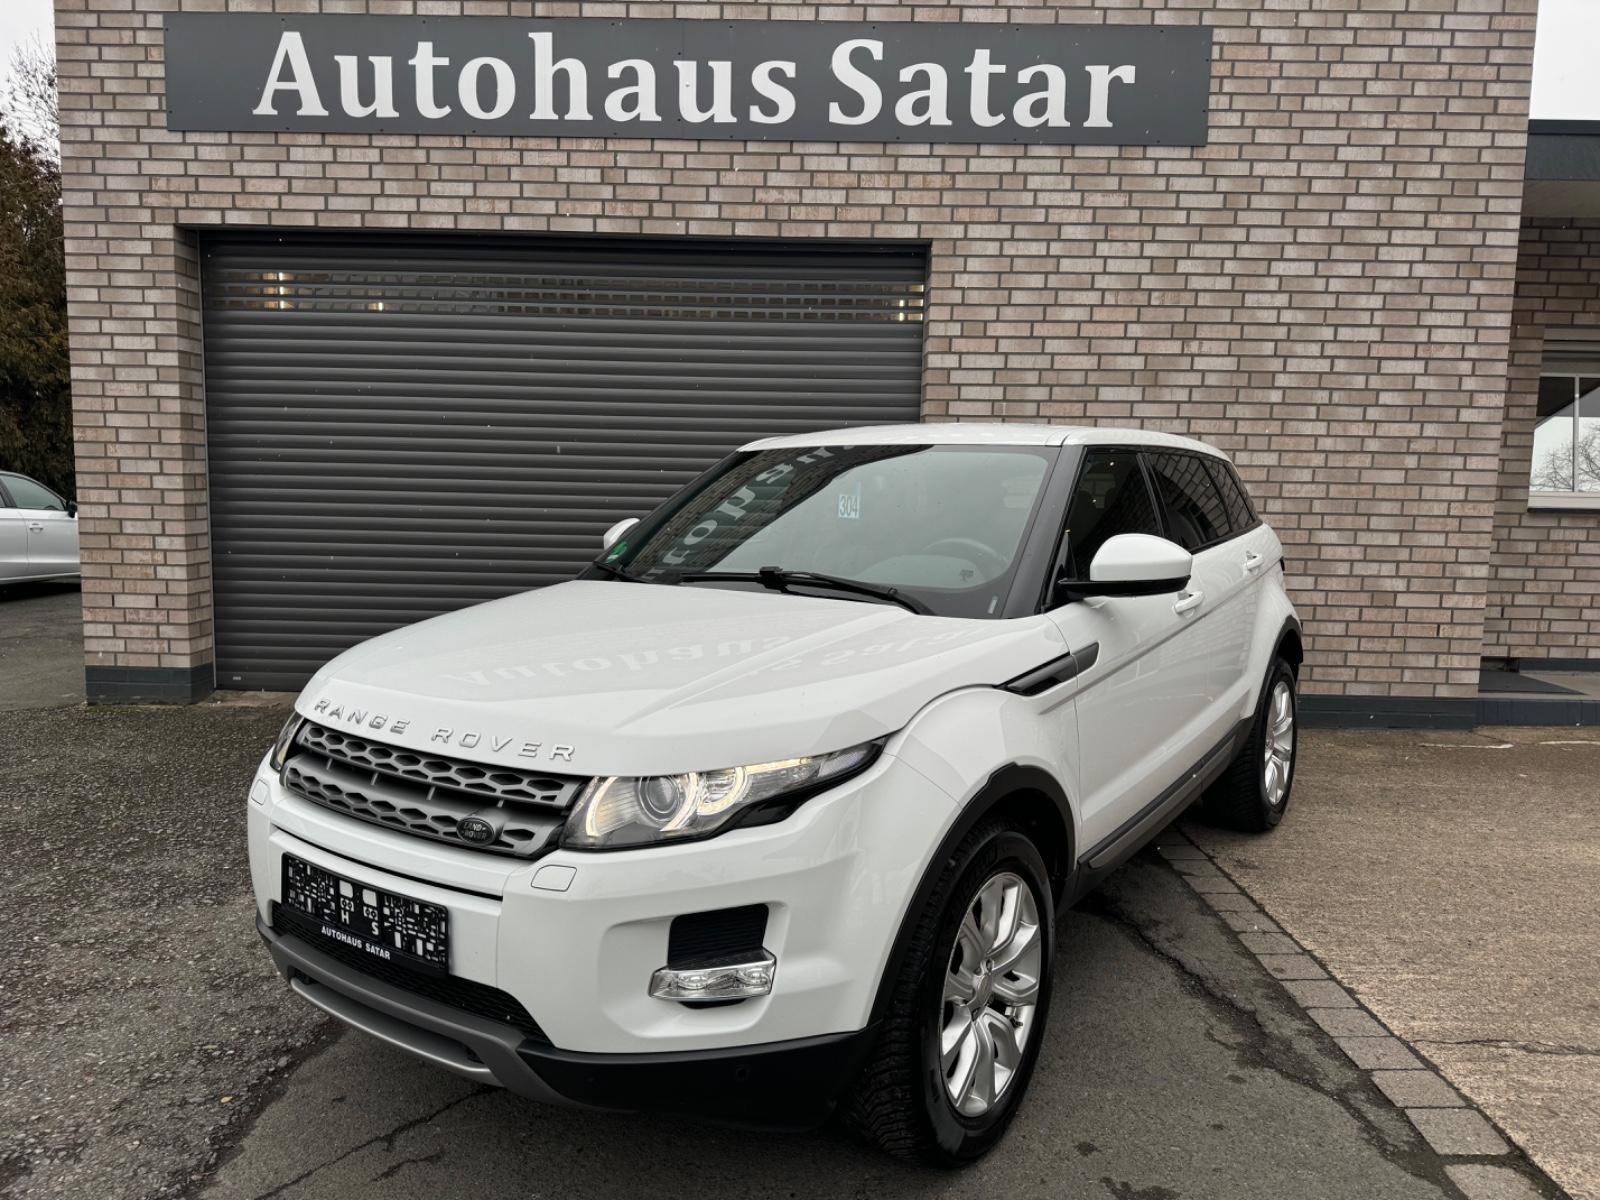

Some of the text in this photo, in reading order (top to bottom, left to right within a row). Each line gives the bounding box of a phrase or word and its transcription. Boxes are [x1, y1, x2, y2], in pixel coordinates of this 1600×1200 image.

[252, 30, 1136, 128] Autohaus Satar
[839, 495, 859, 518] 304
[314, 698, 576, 762] RANGE ROVER
[321, 925, 391, 961] AUTOHAUS SATAR
